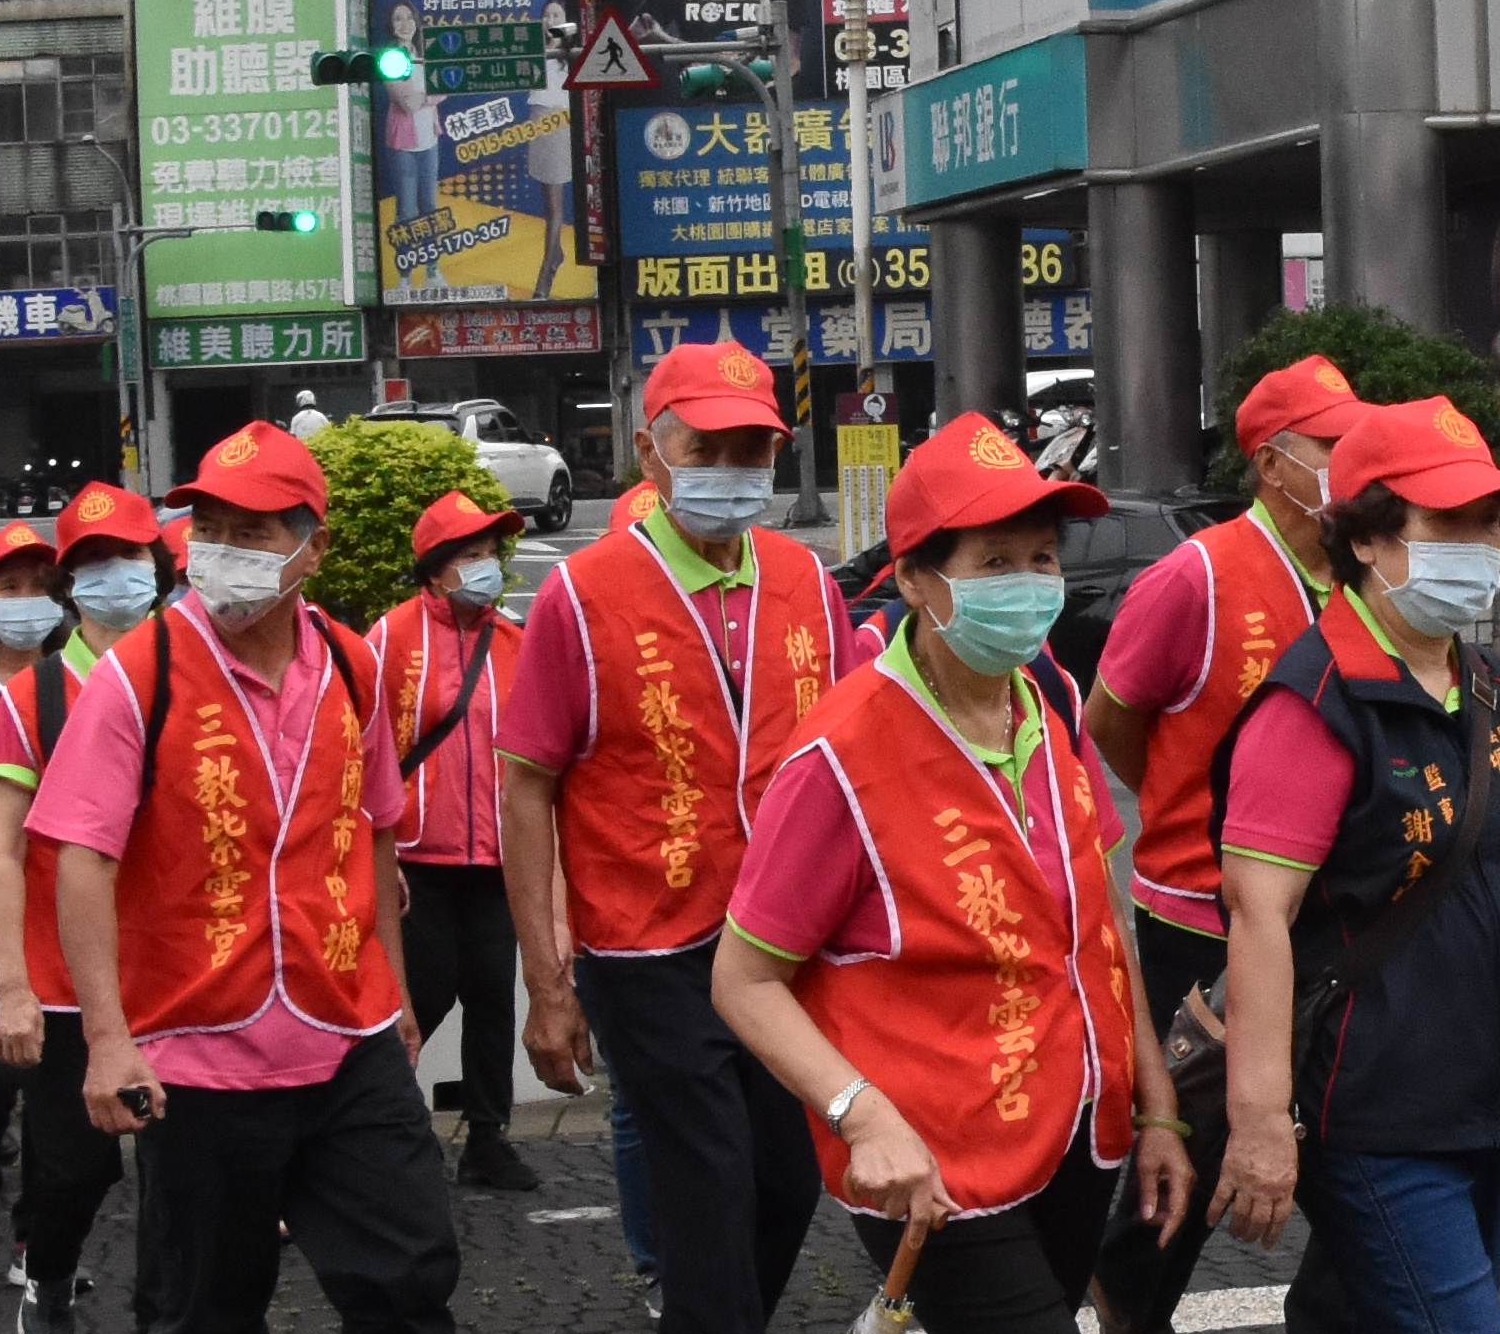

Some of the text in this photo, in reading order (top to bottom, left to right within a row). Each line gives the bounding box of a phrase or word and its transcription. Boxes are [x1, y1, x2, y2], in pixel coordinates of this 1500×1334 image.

[685, 2, 758, 23] ROCK
[169, 39, 321, 96] 助聽器
[466, 60, 531, 78] 中山路
[930, 78, 1019, 175] 聯邦銀行
[151, 154, 341, 194] 免費聽力檢查
[396, 217, 510, 271] 0955-170-367
[156, 318, 357, 365] 維美聽力所
[633, 630, 704, 889] 三教紫雲宮
[191, 703, 251, 971] 三教紫雲宮
[931, 807, 1042, 1123] 三教紫雲宮
